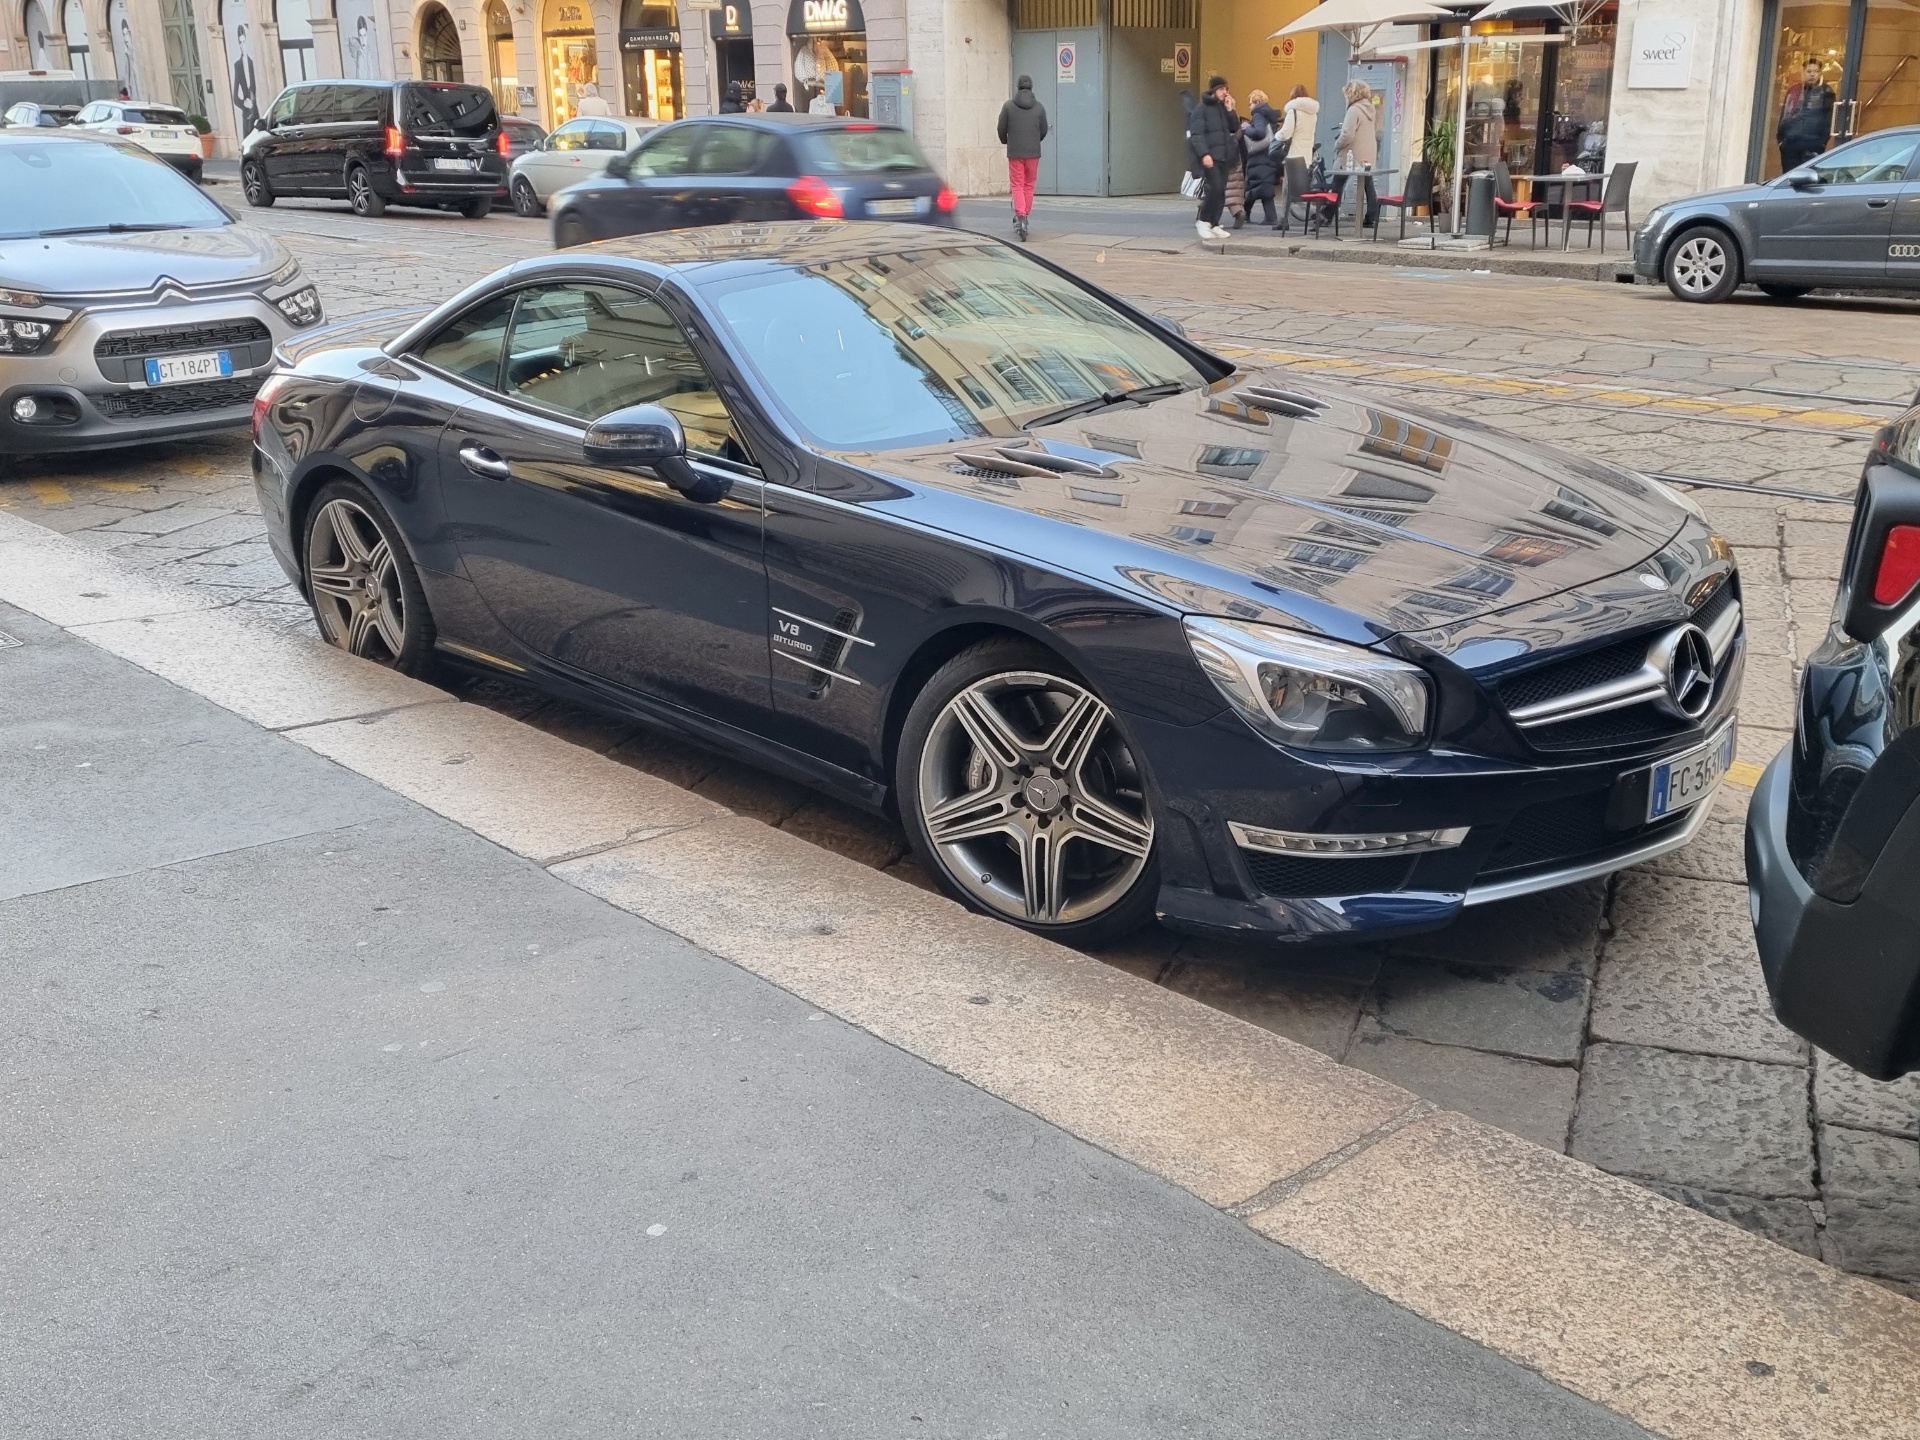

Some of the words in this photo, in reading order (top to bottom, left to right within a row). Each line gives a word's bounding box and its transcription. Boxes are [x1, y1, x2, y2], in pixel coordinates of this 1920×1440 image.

[725, 5, 737, 25] D
[669, 31, 680, 43] 70
[1642, 47, 1676, 60] sweet
[778, 619, 800, 637] V8
[773, 634, 813, 653] BITURBO
